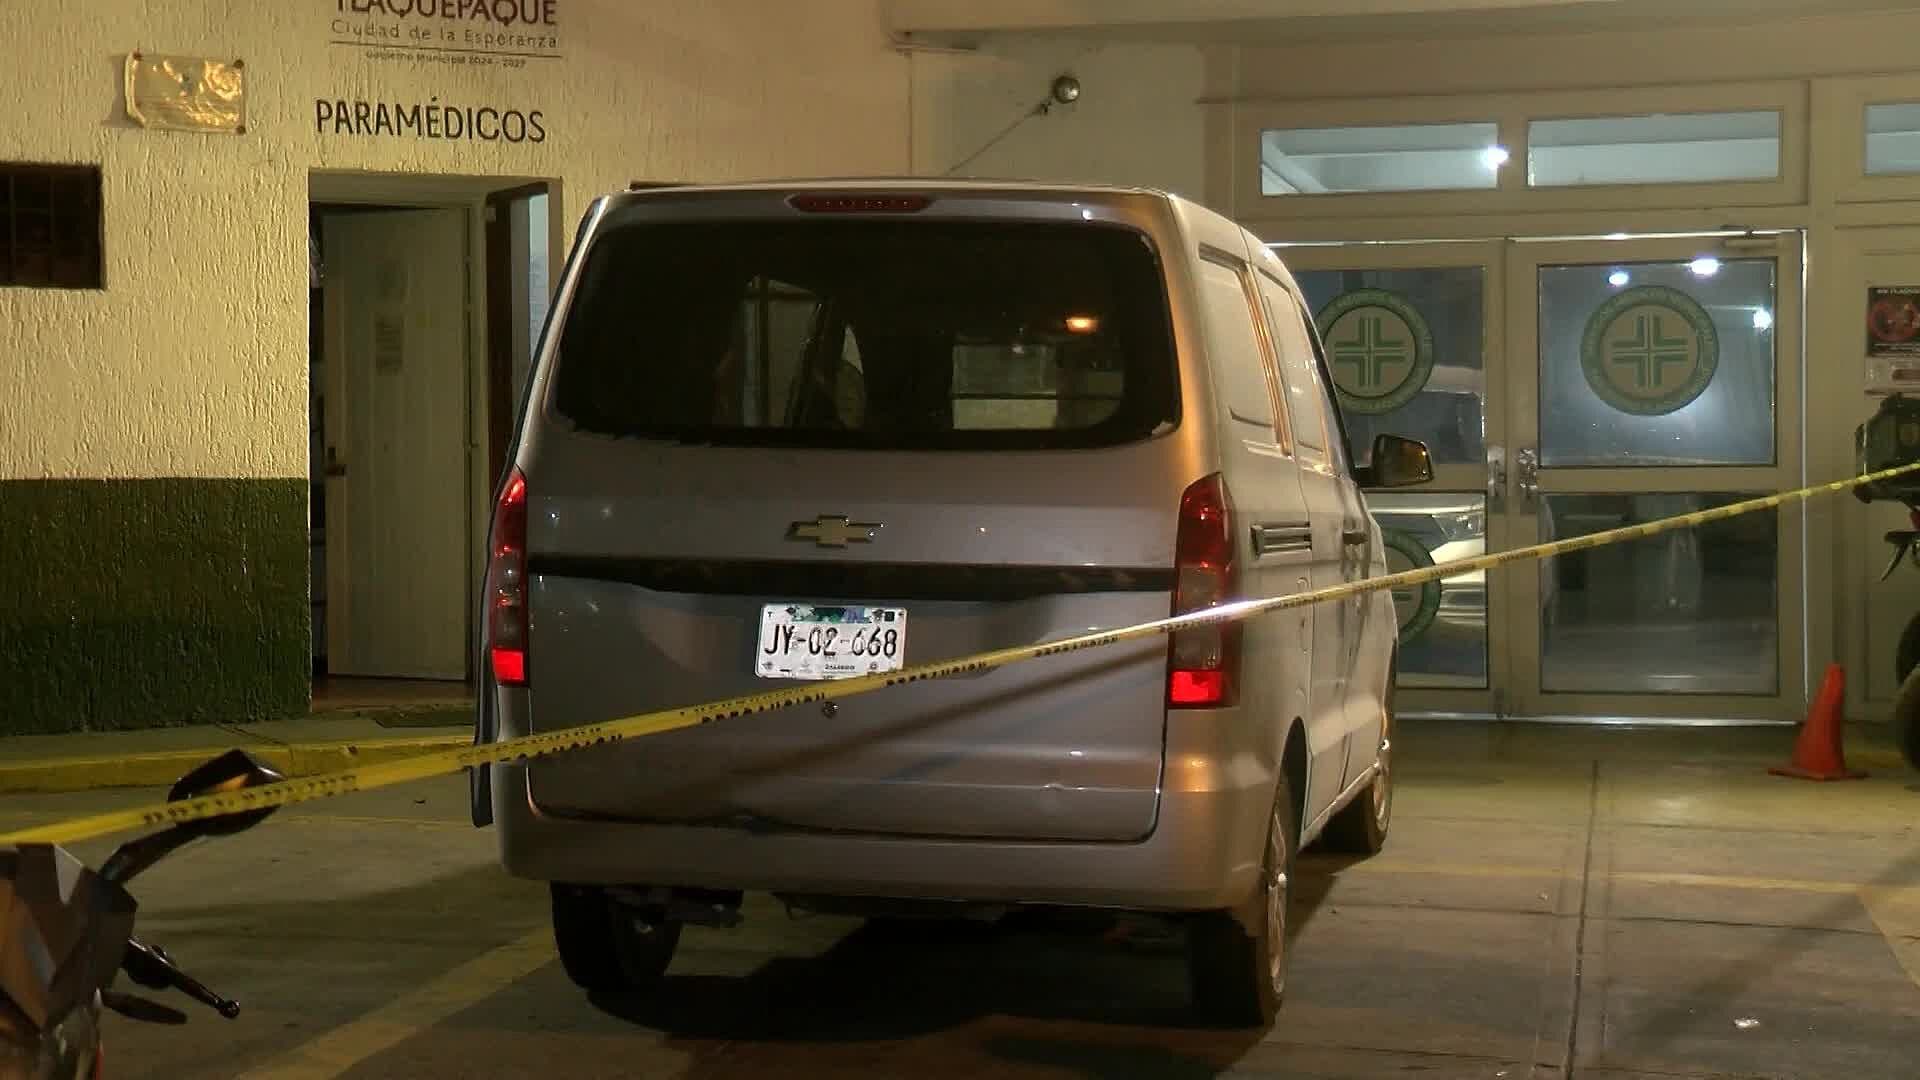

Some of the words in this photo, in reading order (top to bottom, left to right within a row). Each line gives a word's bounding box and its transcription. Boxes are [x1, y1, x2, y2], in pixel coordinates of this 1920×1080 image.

[331, 19, 399, 39] Ciudad
[409, 25, 432, 41] de
[440, 26, 456, 42] la
[464, 29, 557, 48] Esperanza
[316, 96, 546, 143] PARAMÉDICOS
[764, 623, 898, 658] JY-02-668
